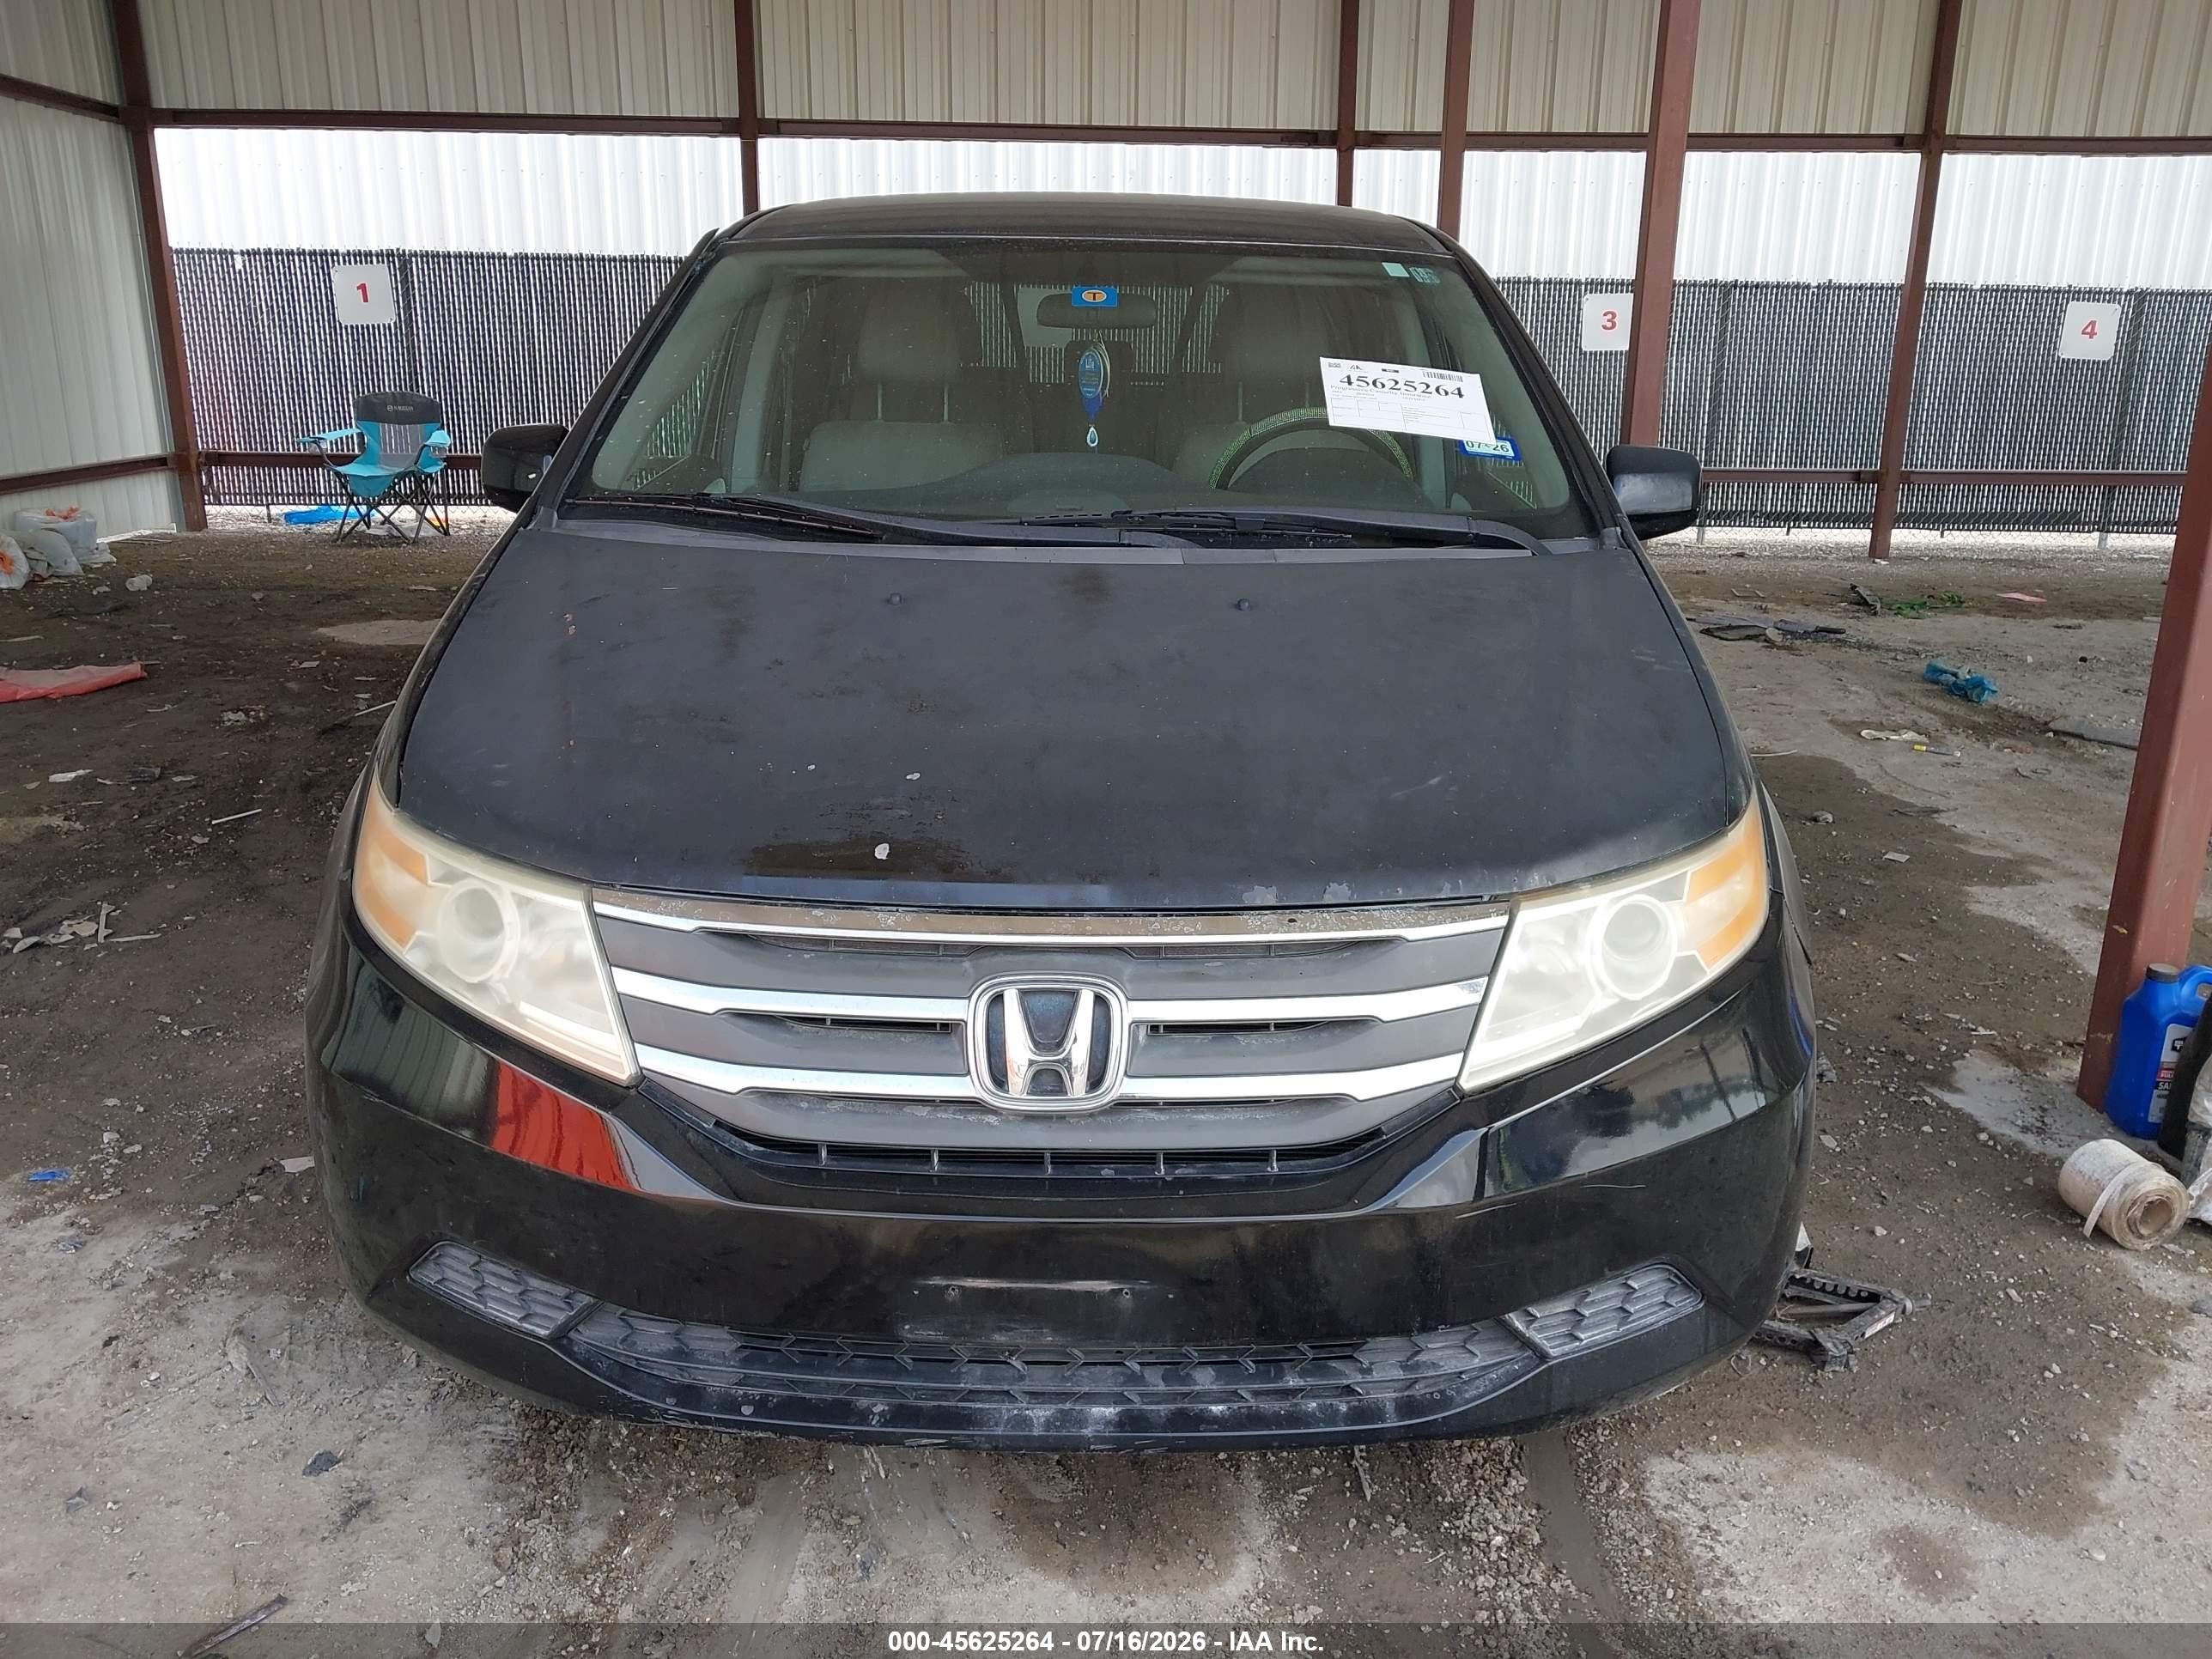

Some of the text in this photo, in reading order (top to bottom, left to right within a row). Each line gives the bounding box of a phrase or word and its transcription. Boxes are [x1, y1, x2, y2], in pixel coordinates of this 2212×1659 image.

[356, 283, 369, 303] 1
[1601, 310, 1618, 331] 3
[2081, 319, 2098, 339] 4
[1339, 374, 1465, 398] 45625264
